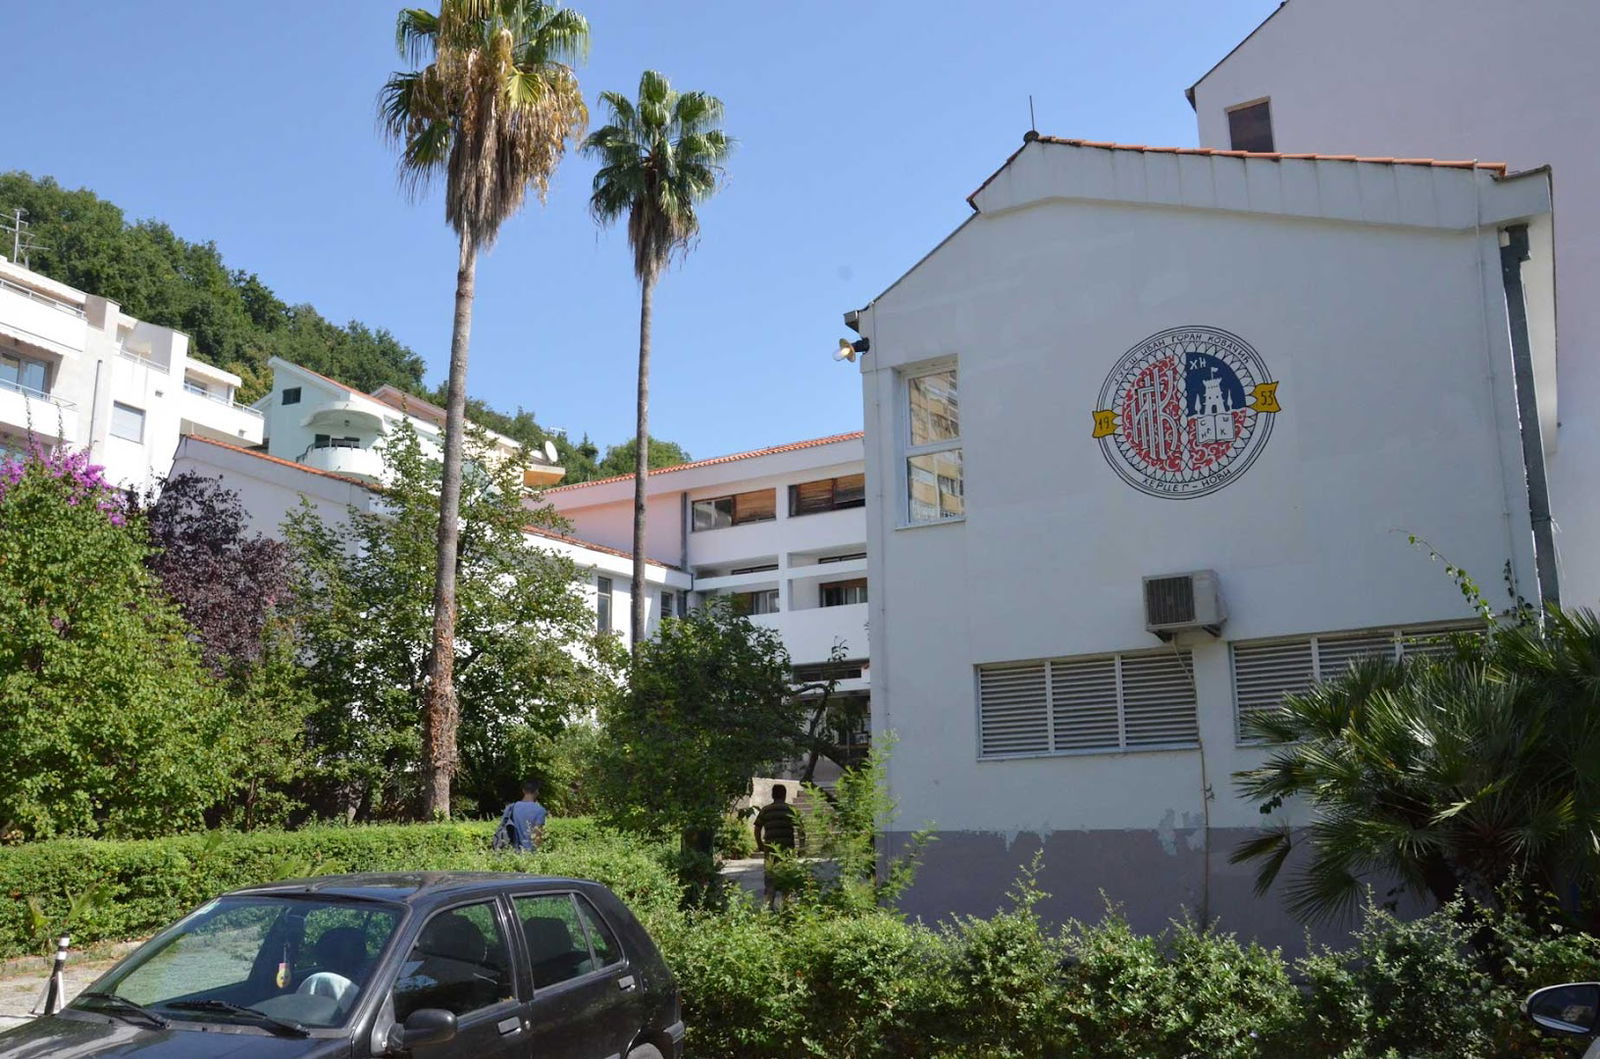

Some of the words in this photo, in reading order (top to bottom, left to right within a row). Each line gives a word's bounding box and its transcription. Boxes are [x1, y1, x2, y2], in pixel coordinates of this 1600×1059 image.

[1140, 339, 1166, 355] ИВАН
[1171, 333, 1202, 343] ГОРАН
[1189, 356, 1207, 370] ХН
[1097, 415, 1109, 432] 19
[1260, 389, 1274, 406] 53
